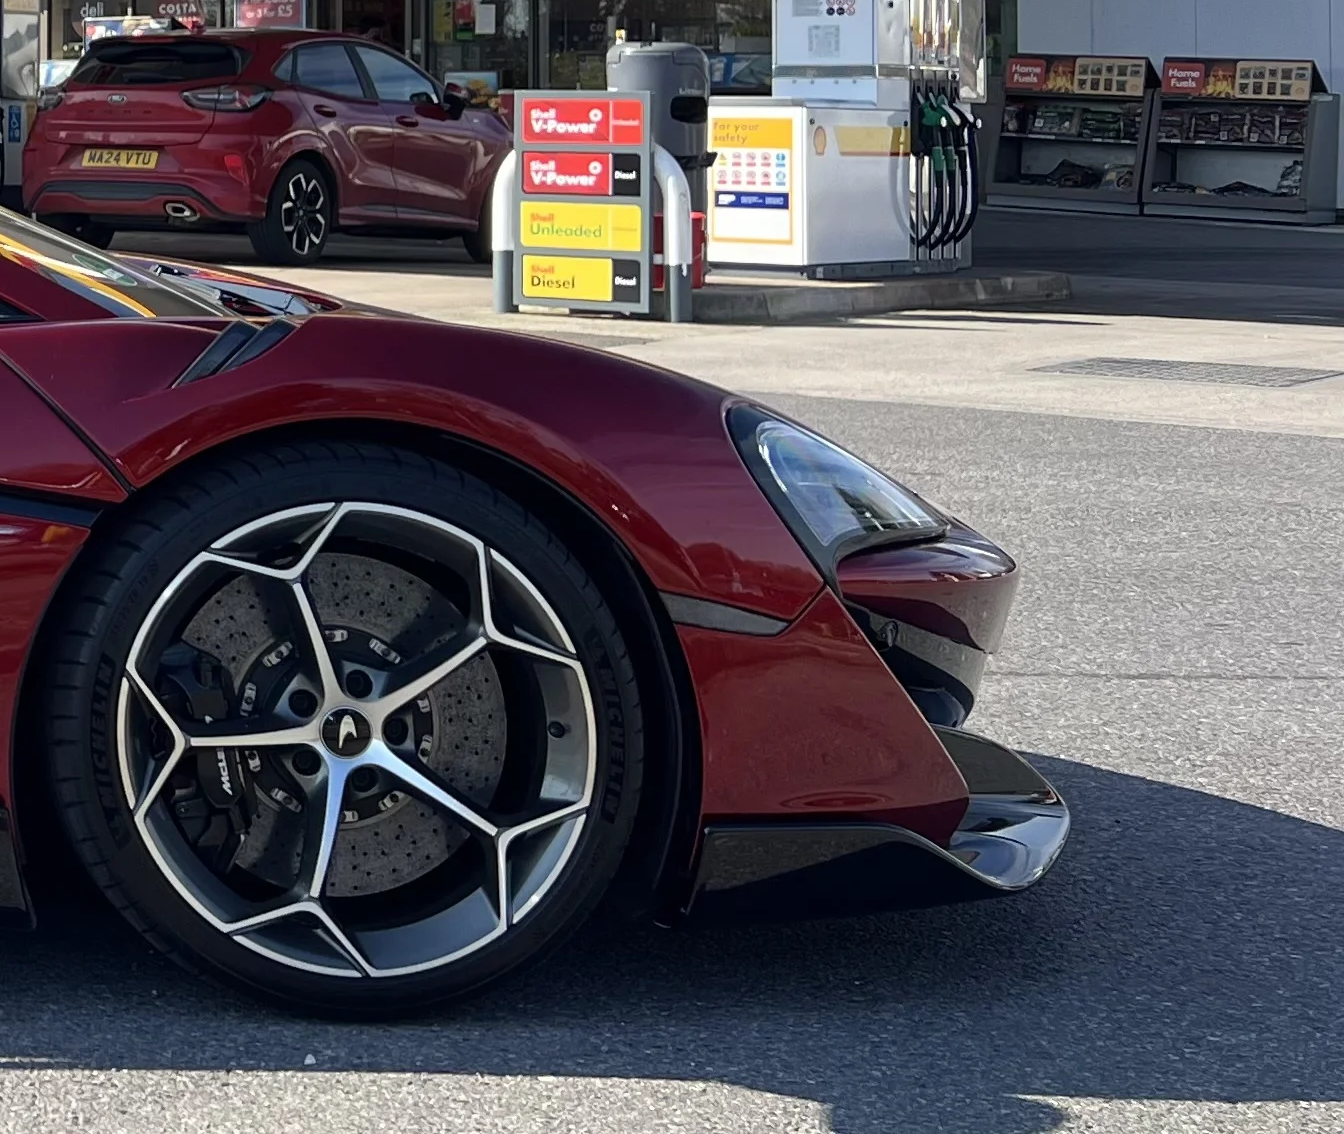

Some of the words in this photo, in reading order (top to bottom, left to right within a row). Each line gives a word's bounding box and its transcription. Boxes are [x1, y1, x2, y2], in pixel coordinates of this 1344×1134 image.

[158, 3, 197, 15] COSTA
[277, 4, 293, 18] £5
[1012, 63, 1042, 74] Home
[1168, 67, 1201, 78] Home
[1013, 73, 1038, 83] Fuels
[1170, 77, 1197, 88] Fuels
[530, 107, 557, 119] Shell
[531, 119, 598, 134] V-Power
[125, 152, 152, 165] VTU
[530, 171, 597, 186] V-Power
[530, 223, 602, 238] Unleaded
[530, 275, 576, 289] Diesel
